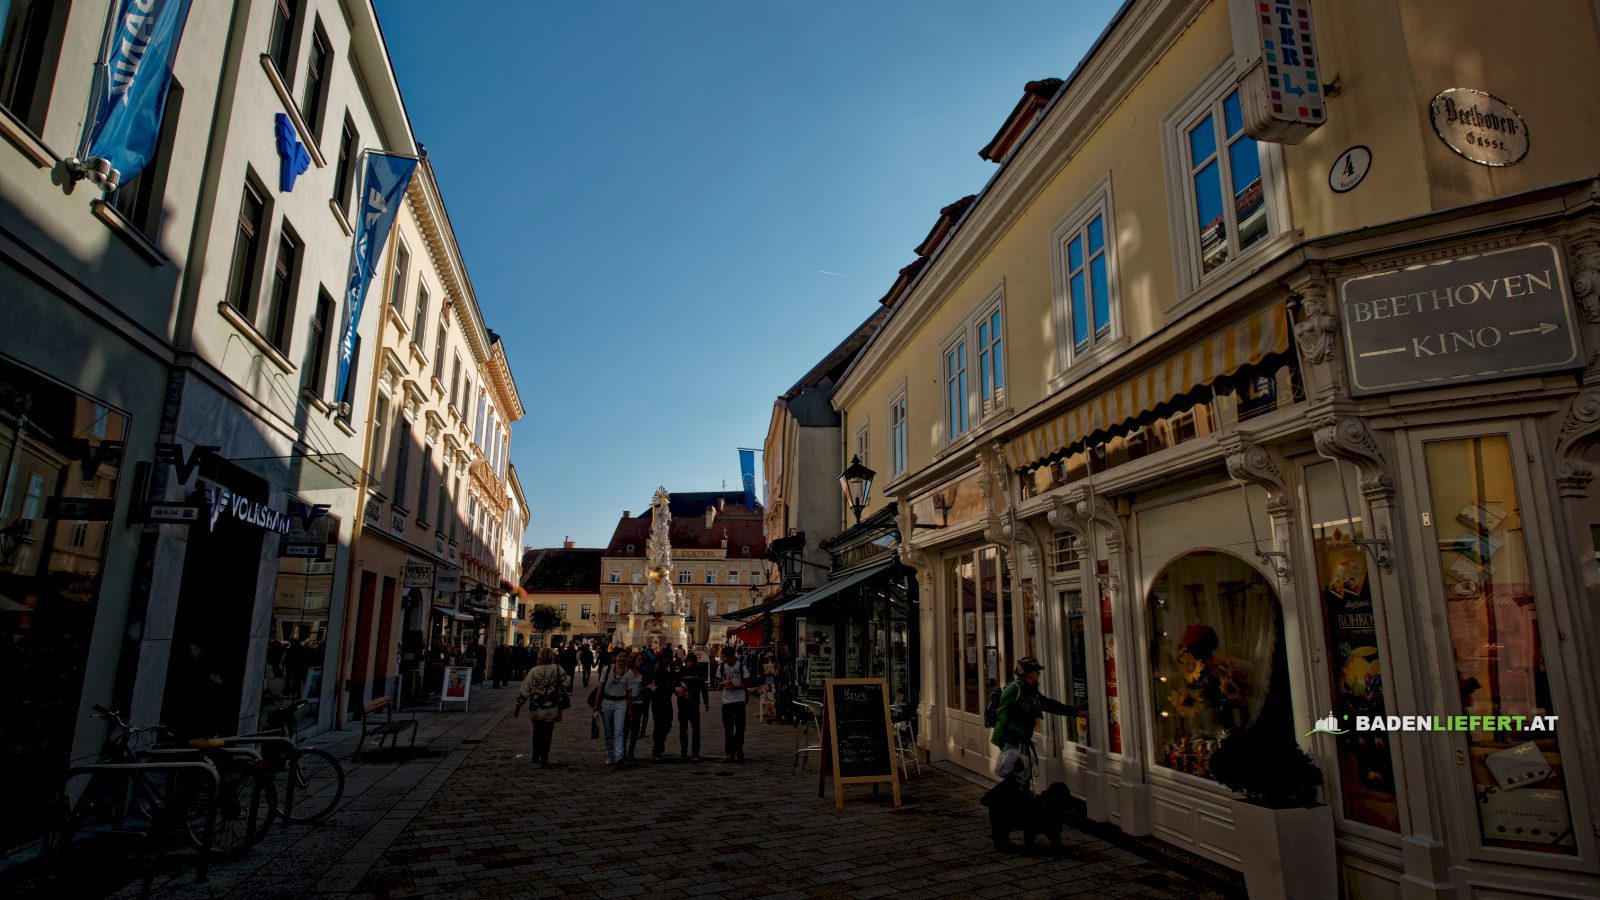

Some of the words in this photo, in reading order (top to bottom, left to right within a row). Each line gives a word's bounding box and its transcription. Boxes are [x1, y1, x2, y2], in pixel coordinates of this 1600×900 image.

[1343, 154, 1354, 176] 4
[1352, 270, 1552, 323] BEETHOVEN
[1410, 326, 1502, 359] KINO
[232, 492, 293, 535] VOLKSBAN
